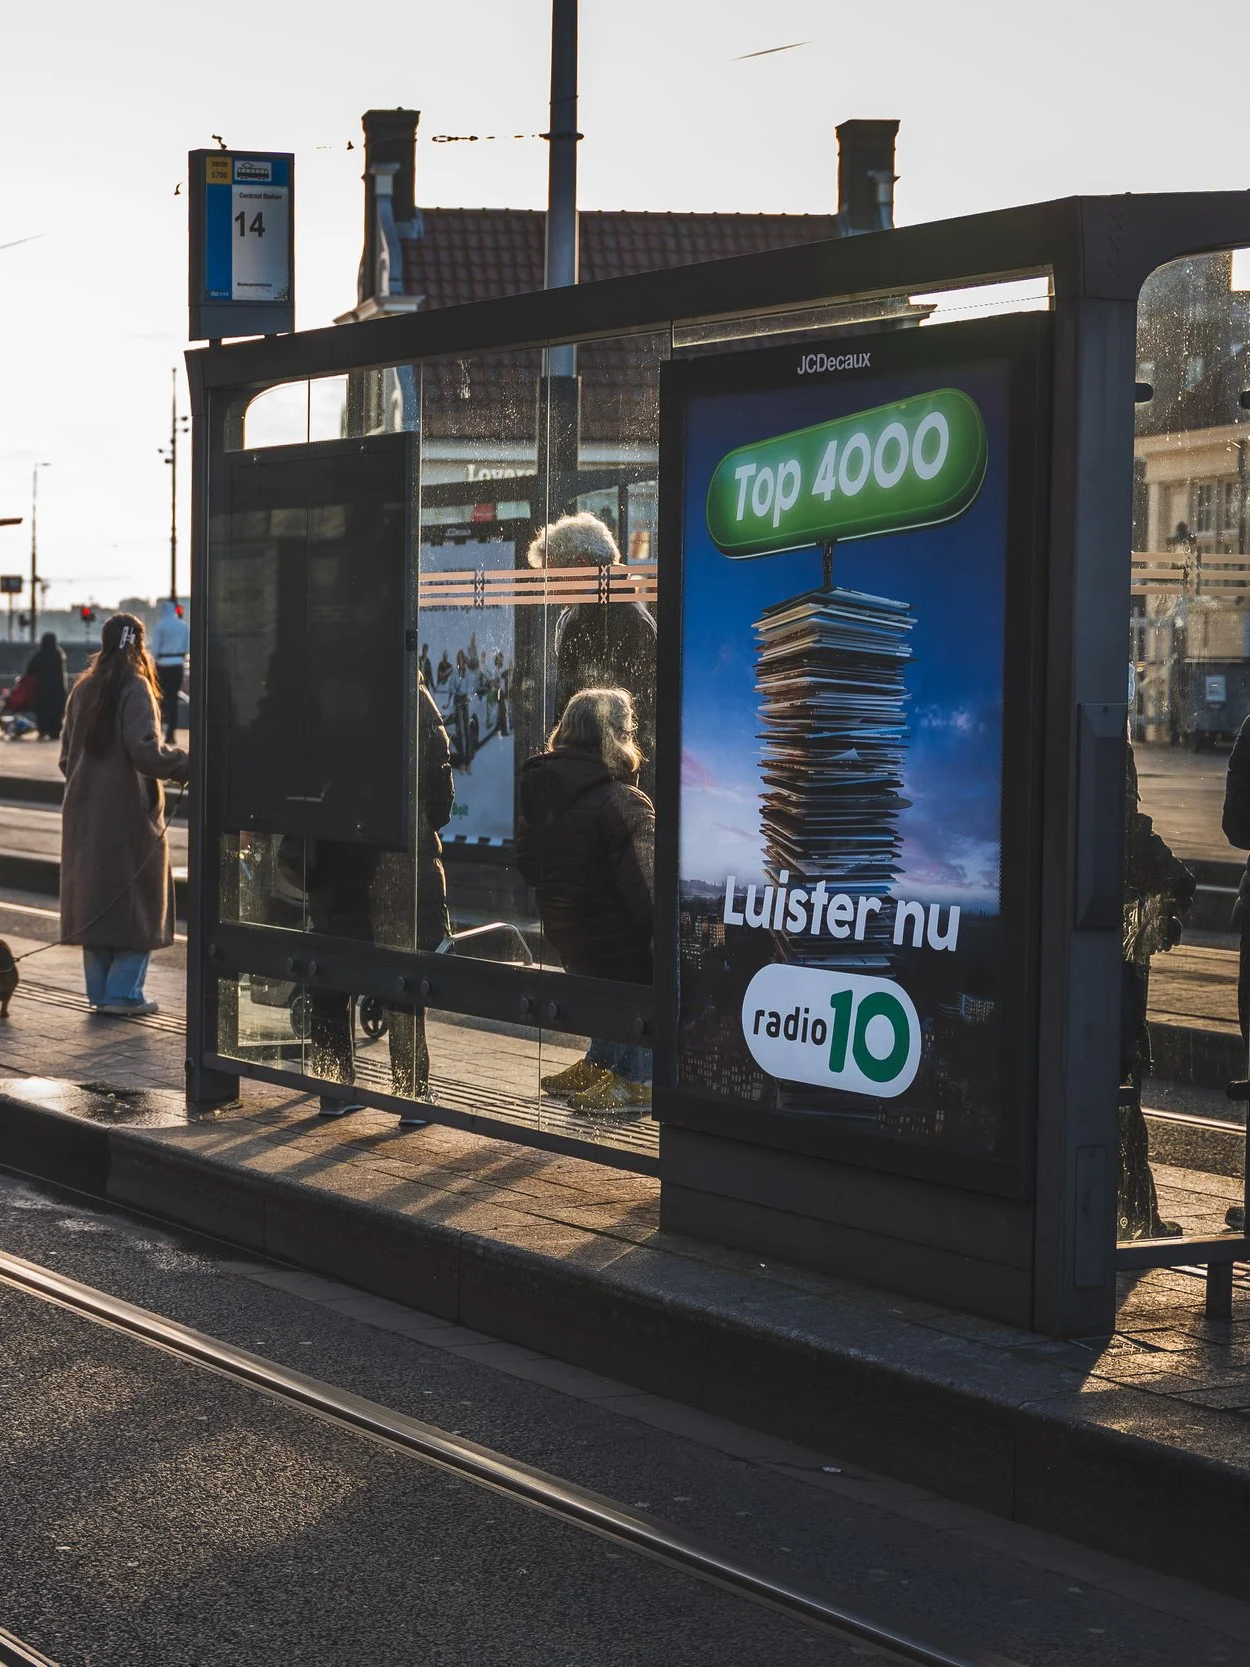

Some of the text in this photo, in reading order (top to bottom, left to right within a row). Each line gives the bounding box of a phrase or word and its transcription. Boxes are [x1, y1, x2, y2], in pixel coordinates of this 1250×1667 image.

[211, 171, 228, 180] 5700
[239, 192, 283, 201] Centraal Station
[234, 211, 266, 238] 14
[796, 352, 871, 375] JCDecaux
[734, 411, 949, 528] Top 4000
[723, 869, 961, 952] Luister nu
[753, 989, 911, 1084] radio 10
